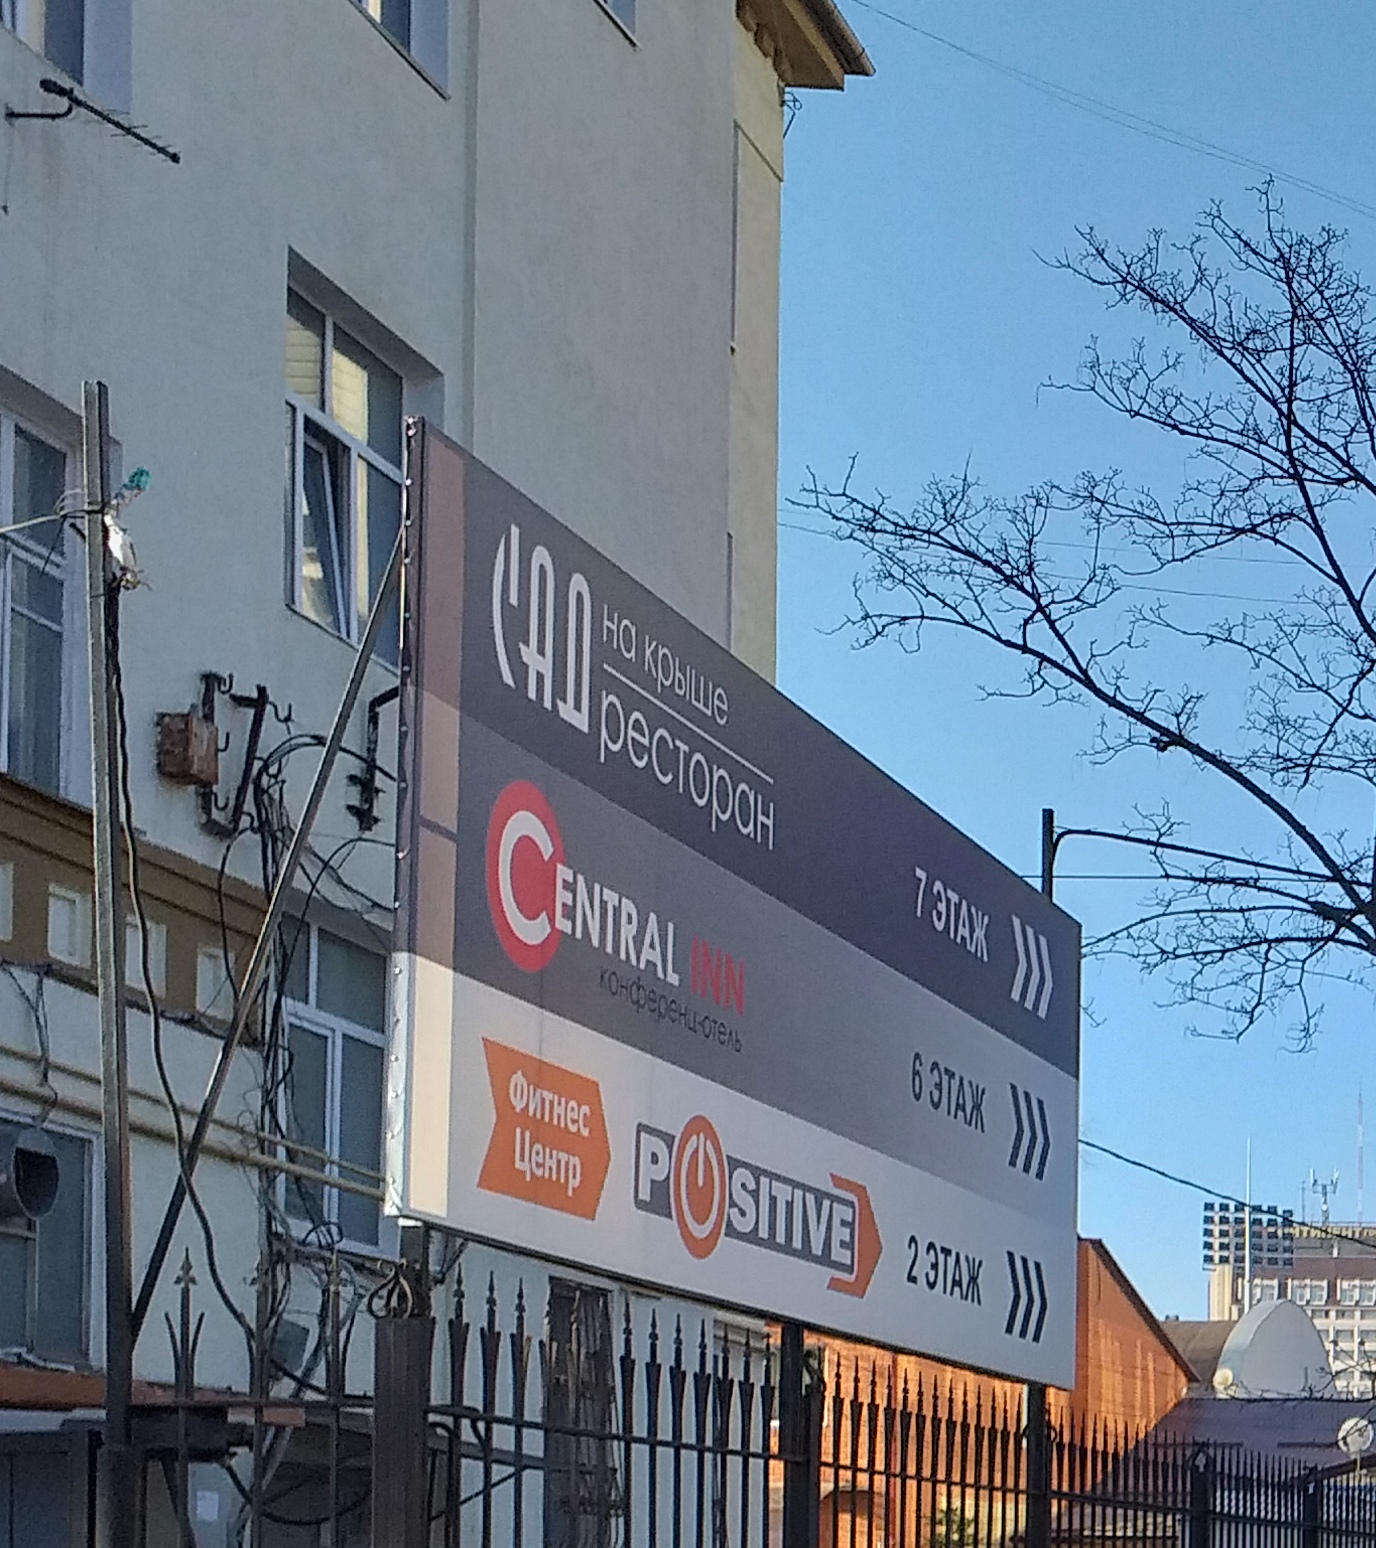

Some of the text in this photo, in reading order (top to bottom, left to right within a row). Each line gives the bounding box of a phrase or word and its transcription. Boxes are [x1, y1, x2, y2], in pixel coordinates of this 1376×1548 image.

[603, 604, 730, 726] на крыше
[600, 689, 774, 850] ресторан
[498, 810, 745, 1017] CENTRAL INN
[914, 867, 990, 963] 7 ЭТАЖ
[600, 967, 743, 1052] конференц-отель
[510, 1069, 590, 1137] Фитнес
[911, 1052, 986, 1134] 6 ЭТАЖ
[515, 1129, 581, 1197] Центр
[907, 1235, 983, 1307] 2 ЭТАЖ
